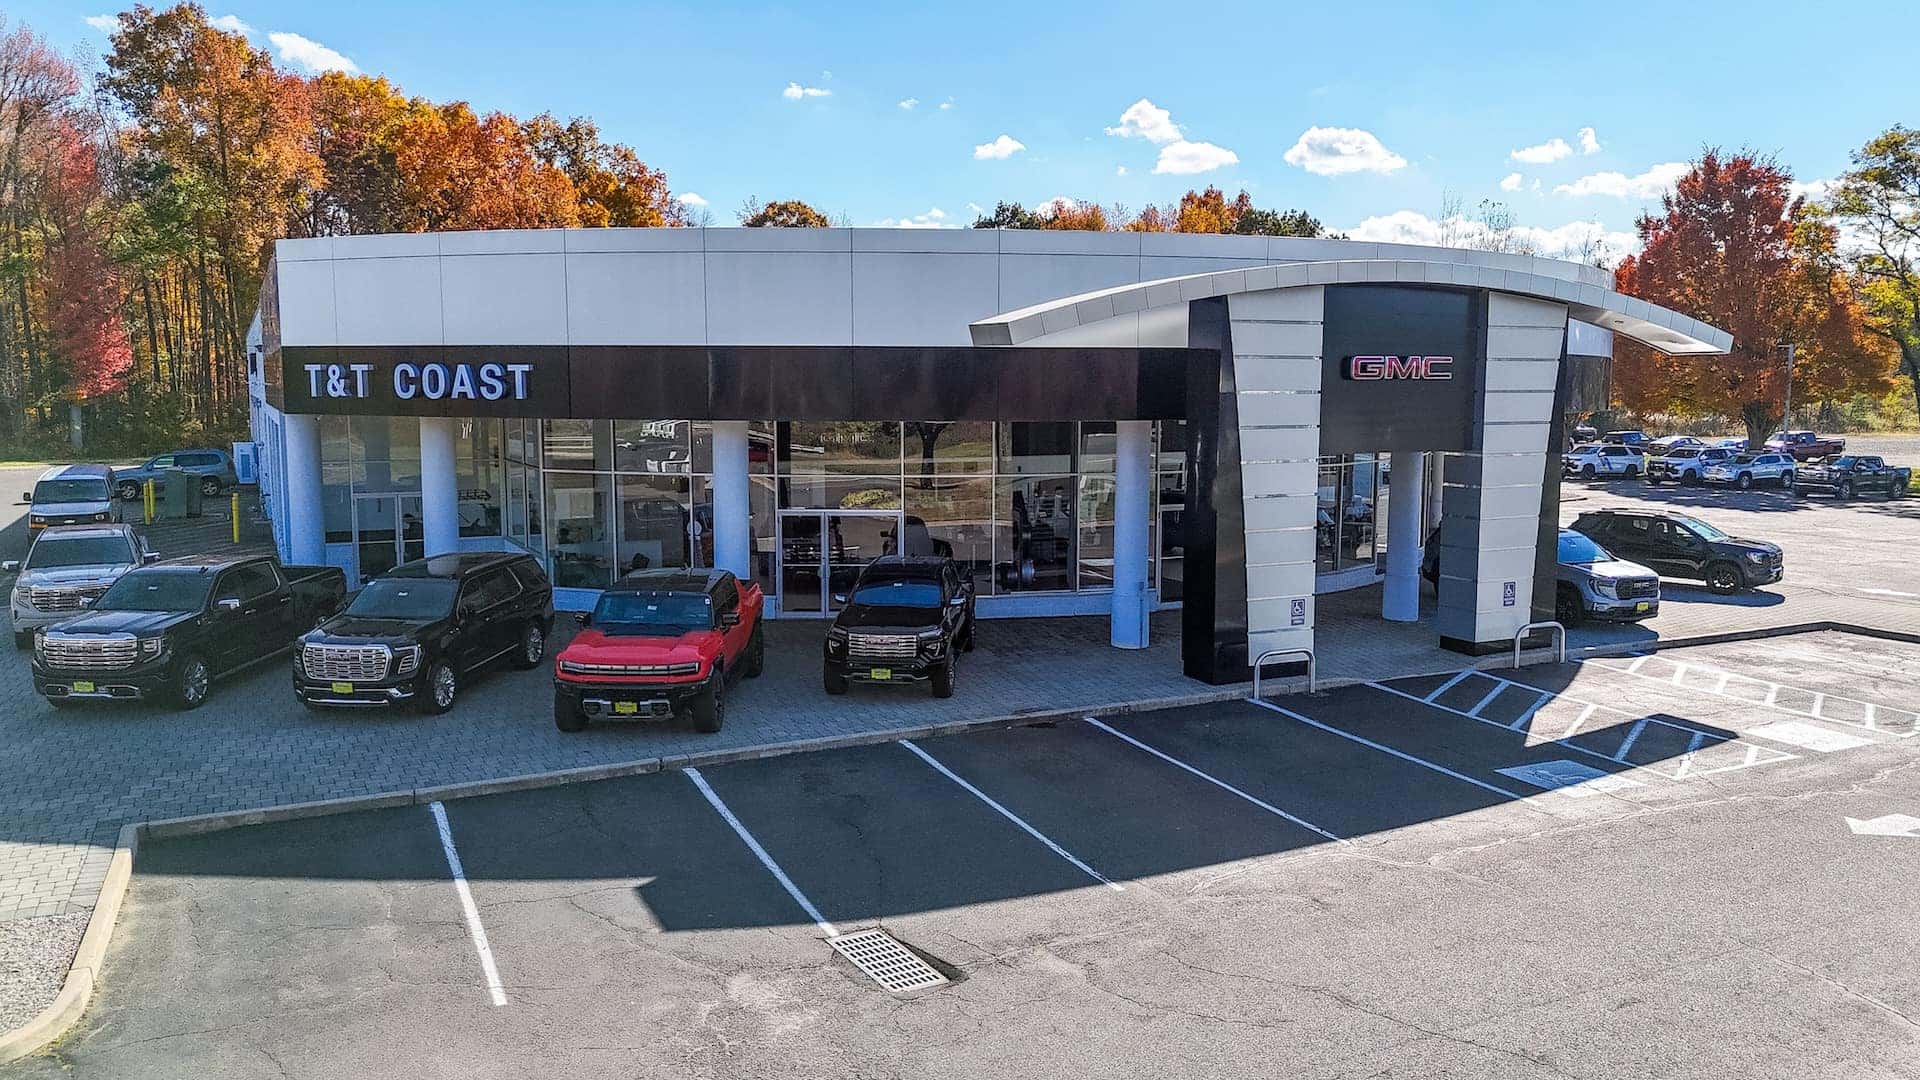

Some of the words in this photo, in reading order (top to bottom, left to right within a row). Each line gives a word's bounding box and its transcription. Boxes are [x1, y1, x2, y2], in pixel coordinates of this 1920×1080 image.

[303, 363, 372, 398] T&T
[392, 363, 532, 400] COAST
[1352, 355, 1453, 380] GMC
